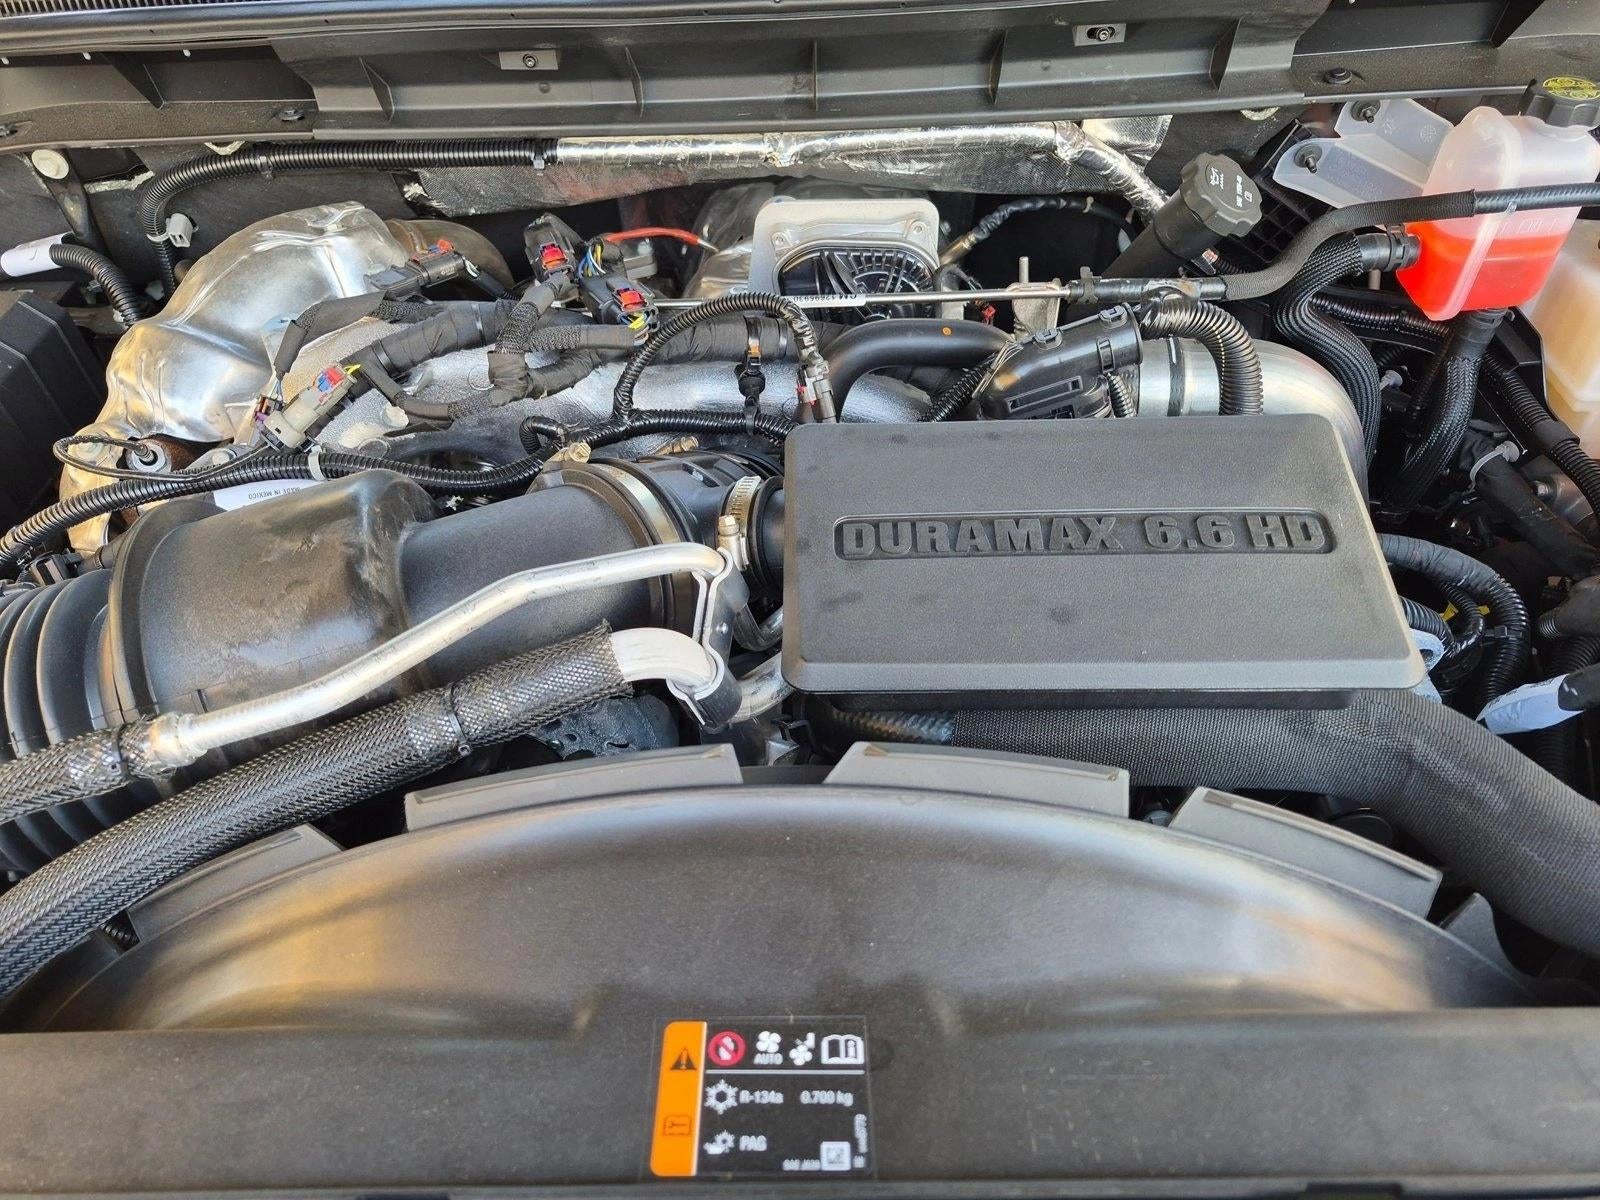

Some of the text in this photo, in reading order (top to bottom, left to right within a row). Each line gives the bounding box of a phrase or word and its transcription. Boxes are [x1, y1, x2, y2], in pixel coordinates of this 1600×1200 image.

[248, 491, 273, 500] MEXICO
[842, 512, 1327, 556] DURAMAX 6.6 HD
[753, 1053, 784, 1065] AUTO
[739, 1089, 784, 1104] R-134a
[836, 1090, 854, 1107] kg
[739, 1135, 768, 1152] PAG
